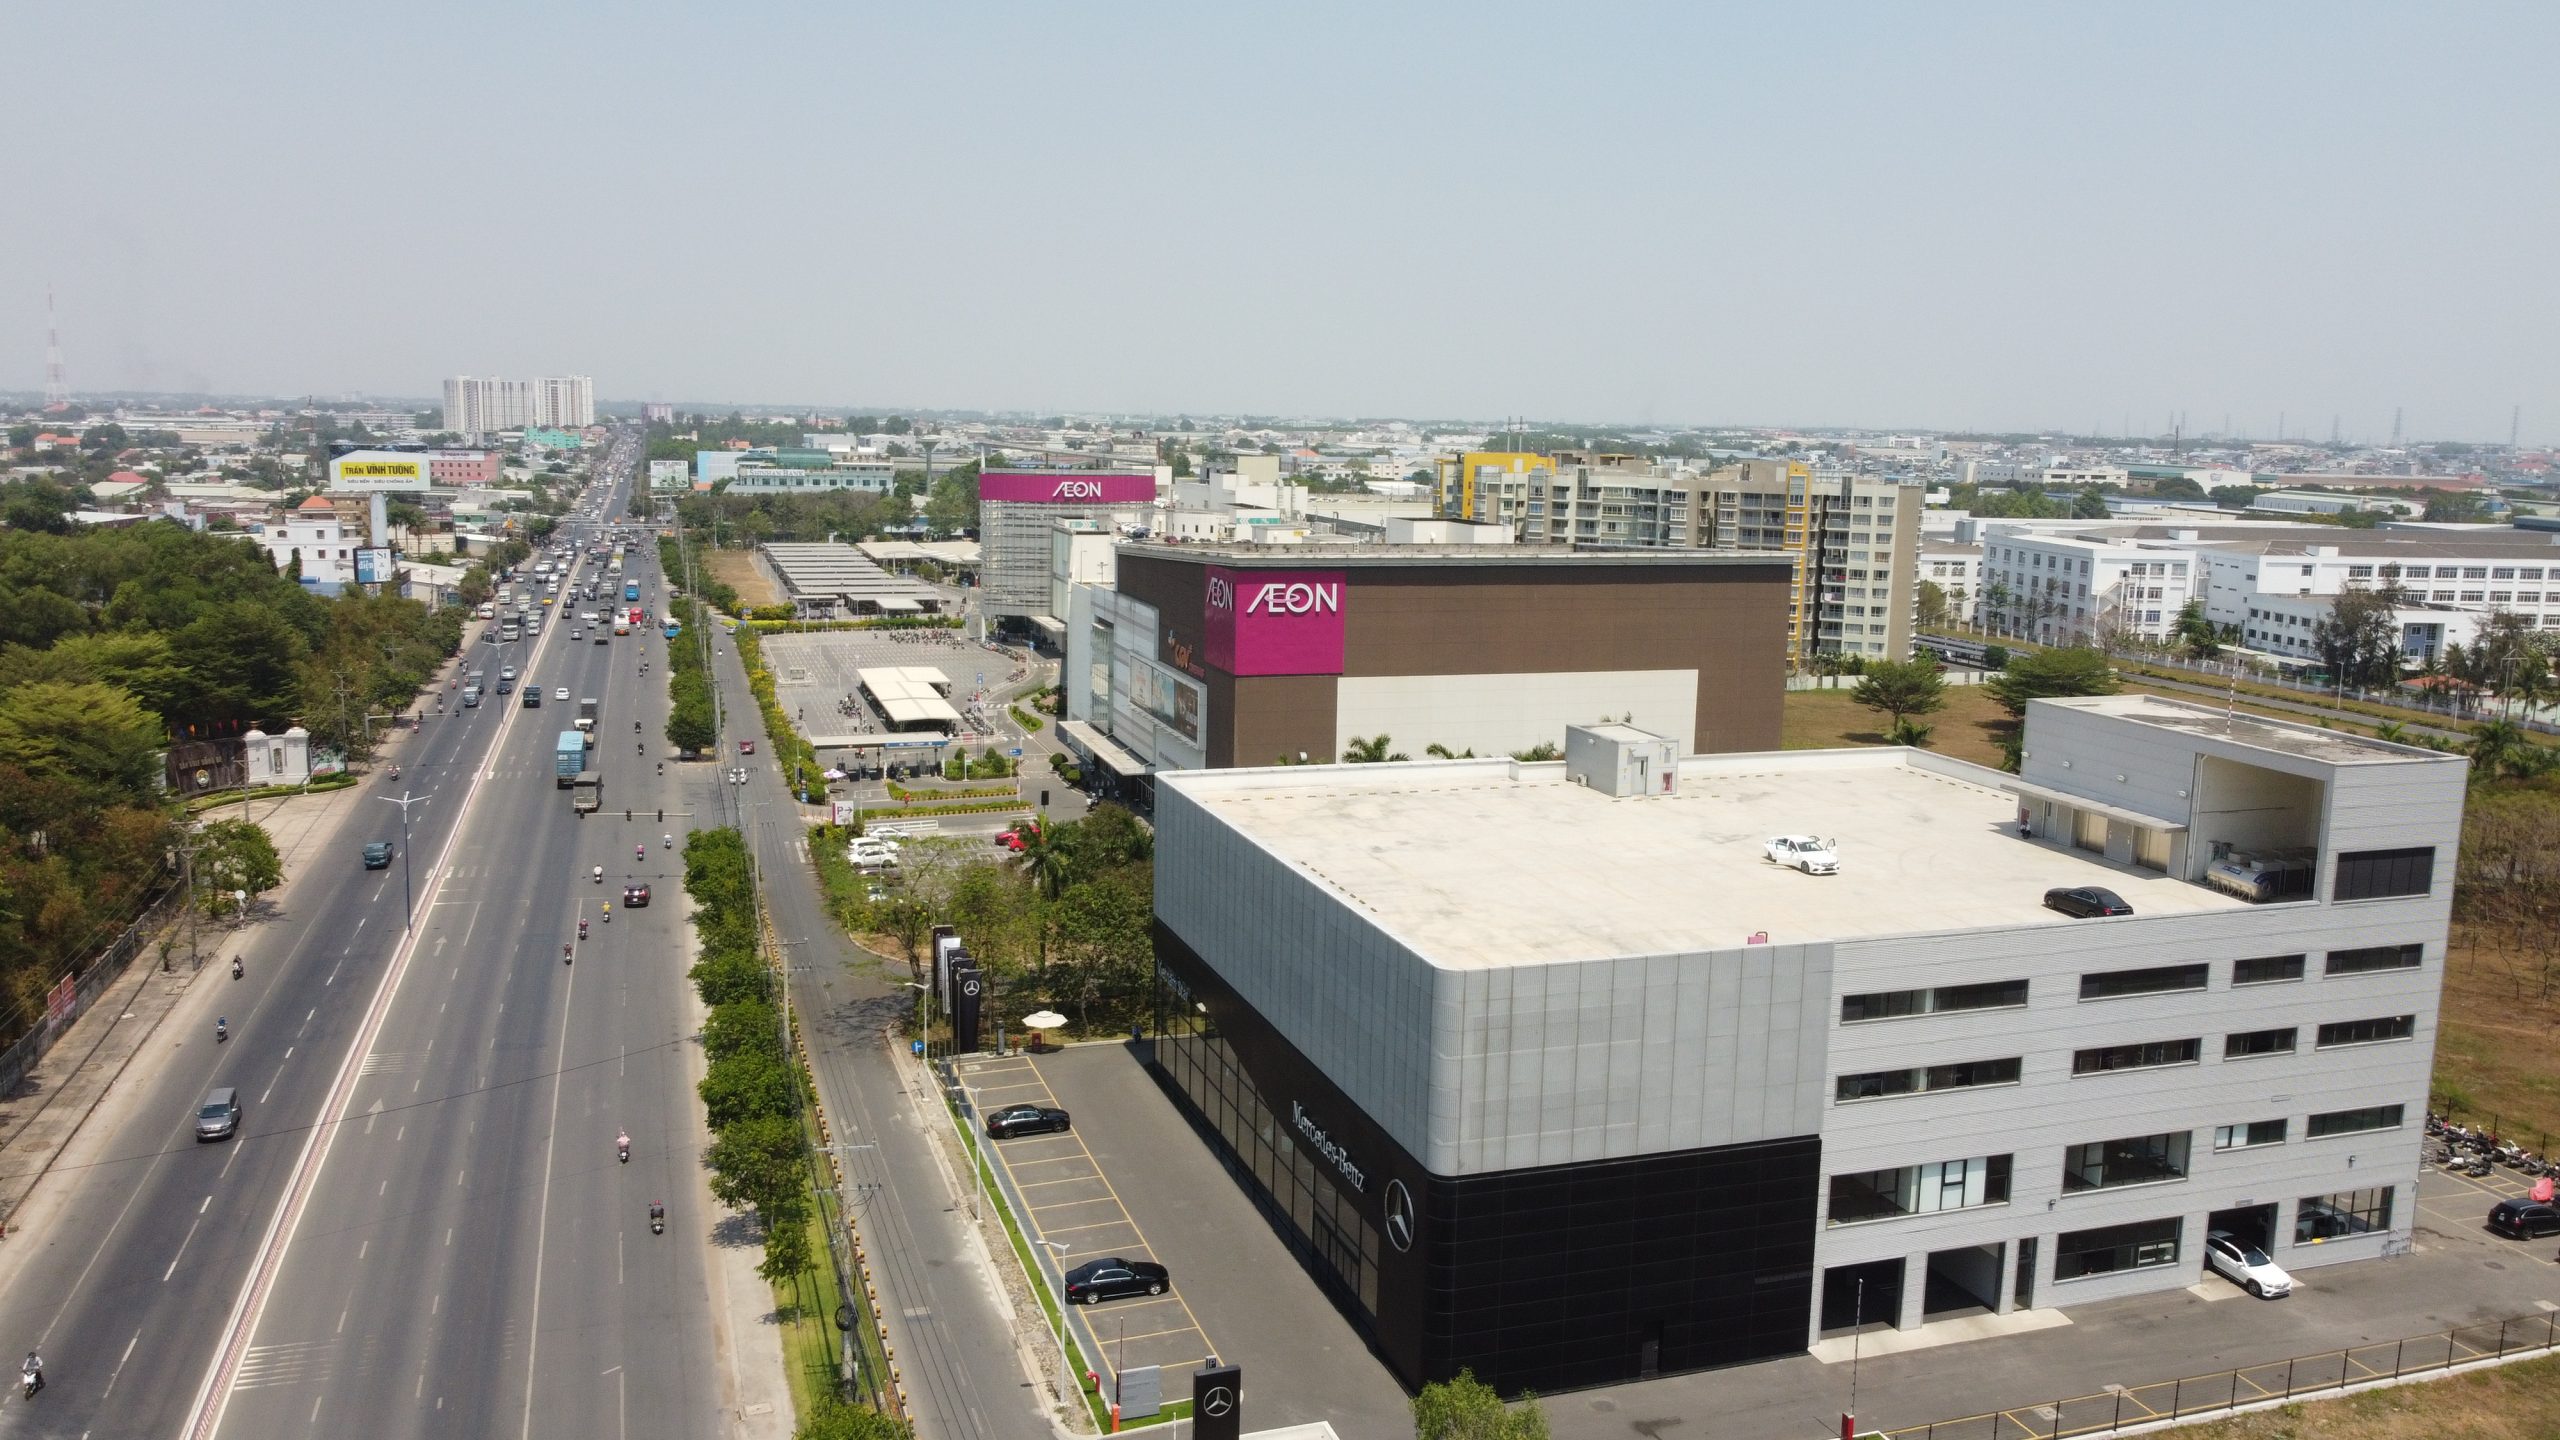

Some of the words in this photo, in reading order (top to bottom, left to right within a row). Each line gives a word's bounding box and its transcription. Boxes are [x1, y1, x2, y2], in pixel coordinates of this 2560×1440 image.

[1246, 582, 1338, 614] AEON
[837, 806, 844, 815] P
[1292, 1100, 1366, 1193] Mercedes-Benz
